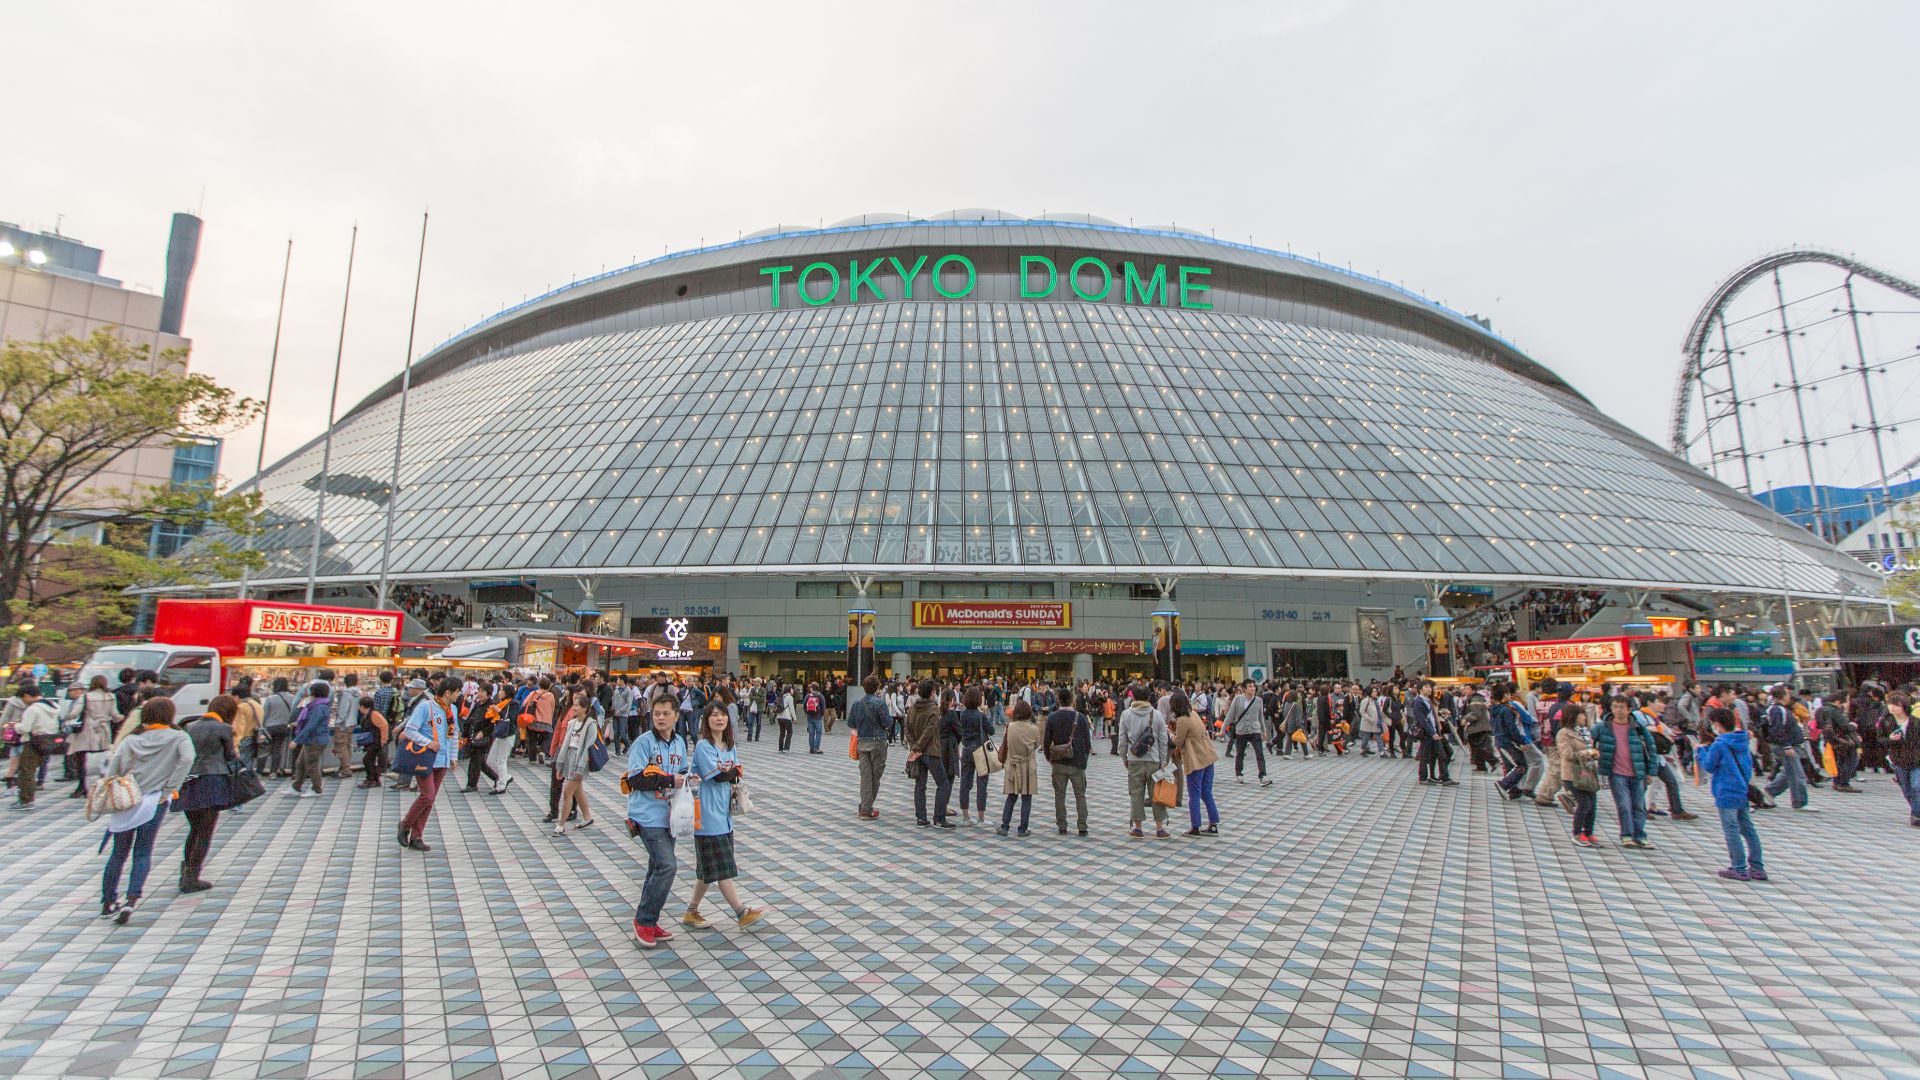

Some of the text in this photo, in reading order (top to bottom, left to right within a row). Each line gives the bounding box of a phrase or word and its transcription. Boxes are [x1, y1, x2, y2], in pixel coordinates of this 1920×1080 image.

[759, 254, 1214, 310] TOKYO DOME
[946, 608, 1063, 619] McDonald's SUNDAY
[261, 611, 354, 633] BASEBALL
[1049, 641, 1138, 651] シーズンシート専用ゲート
[1518, 645, 1584, 660] BASEBALL
